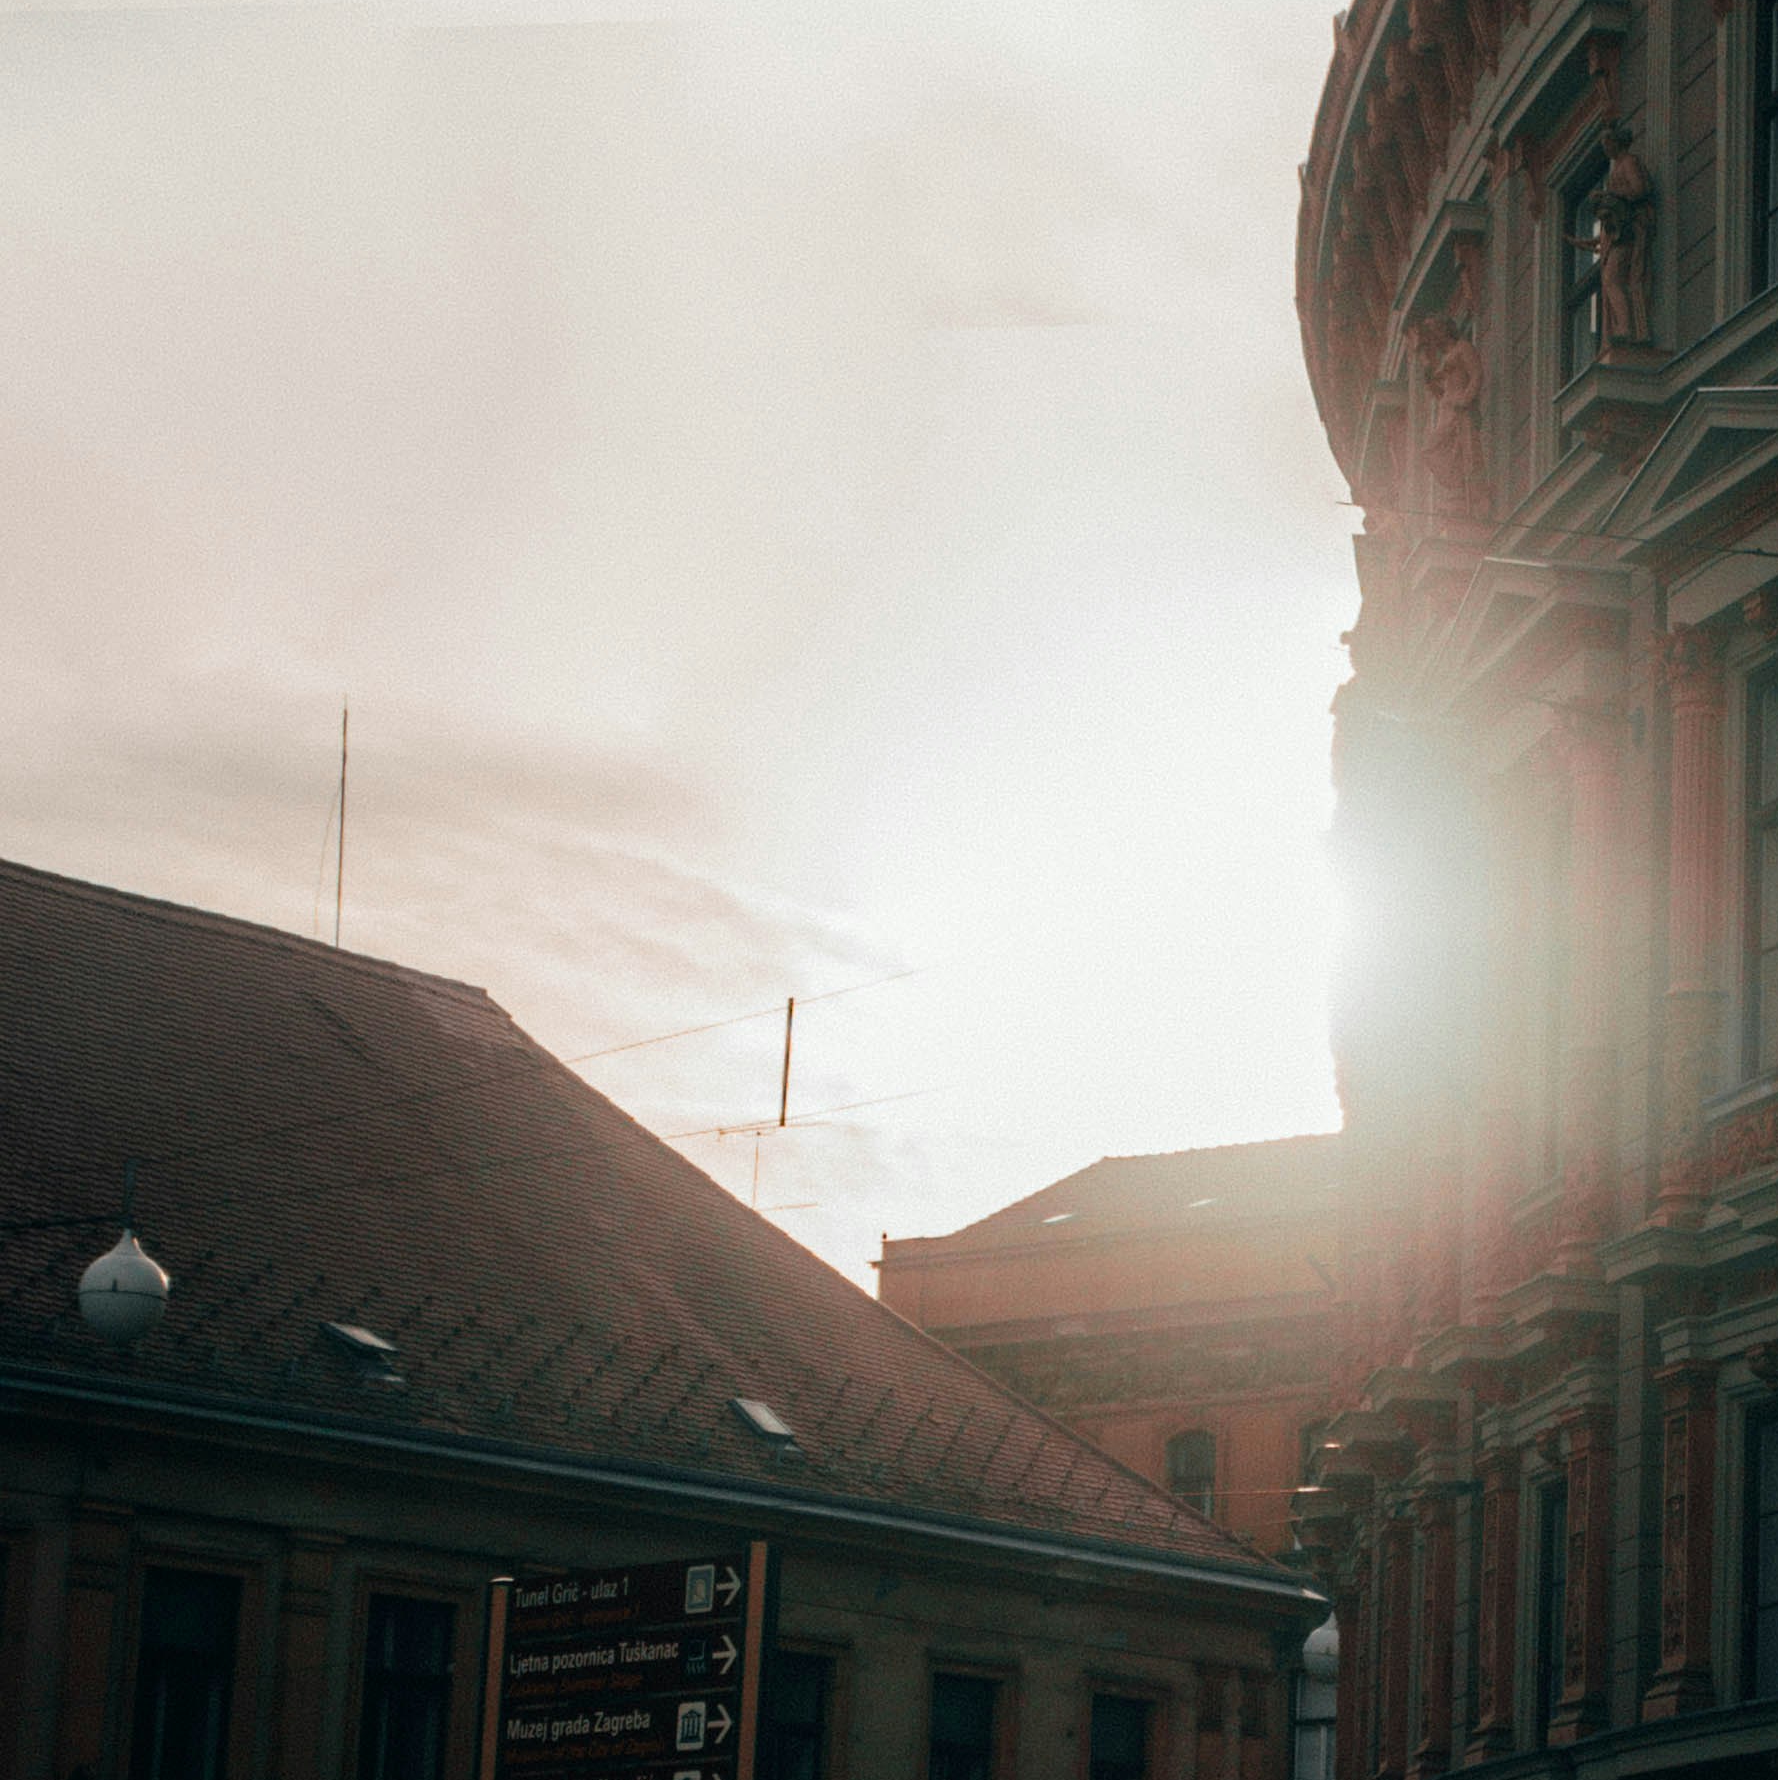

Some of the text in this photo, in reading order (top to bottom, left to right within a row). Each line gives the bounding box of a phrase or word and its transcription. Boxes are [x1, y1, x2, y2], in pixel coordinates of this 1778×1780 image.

[514, 1585, 549, 1608] Tunel
[591, 1580, 618, 1600] ulaz
[622, 1575, 630, 1596] 1
[509, 1641, 680, 1676] Ljetna pozornica Tuškanac
[507, 1710, 652, 1742] Muzej grada Zagreba
